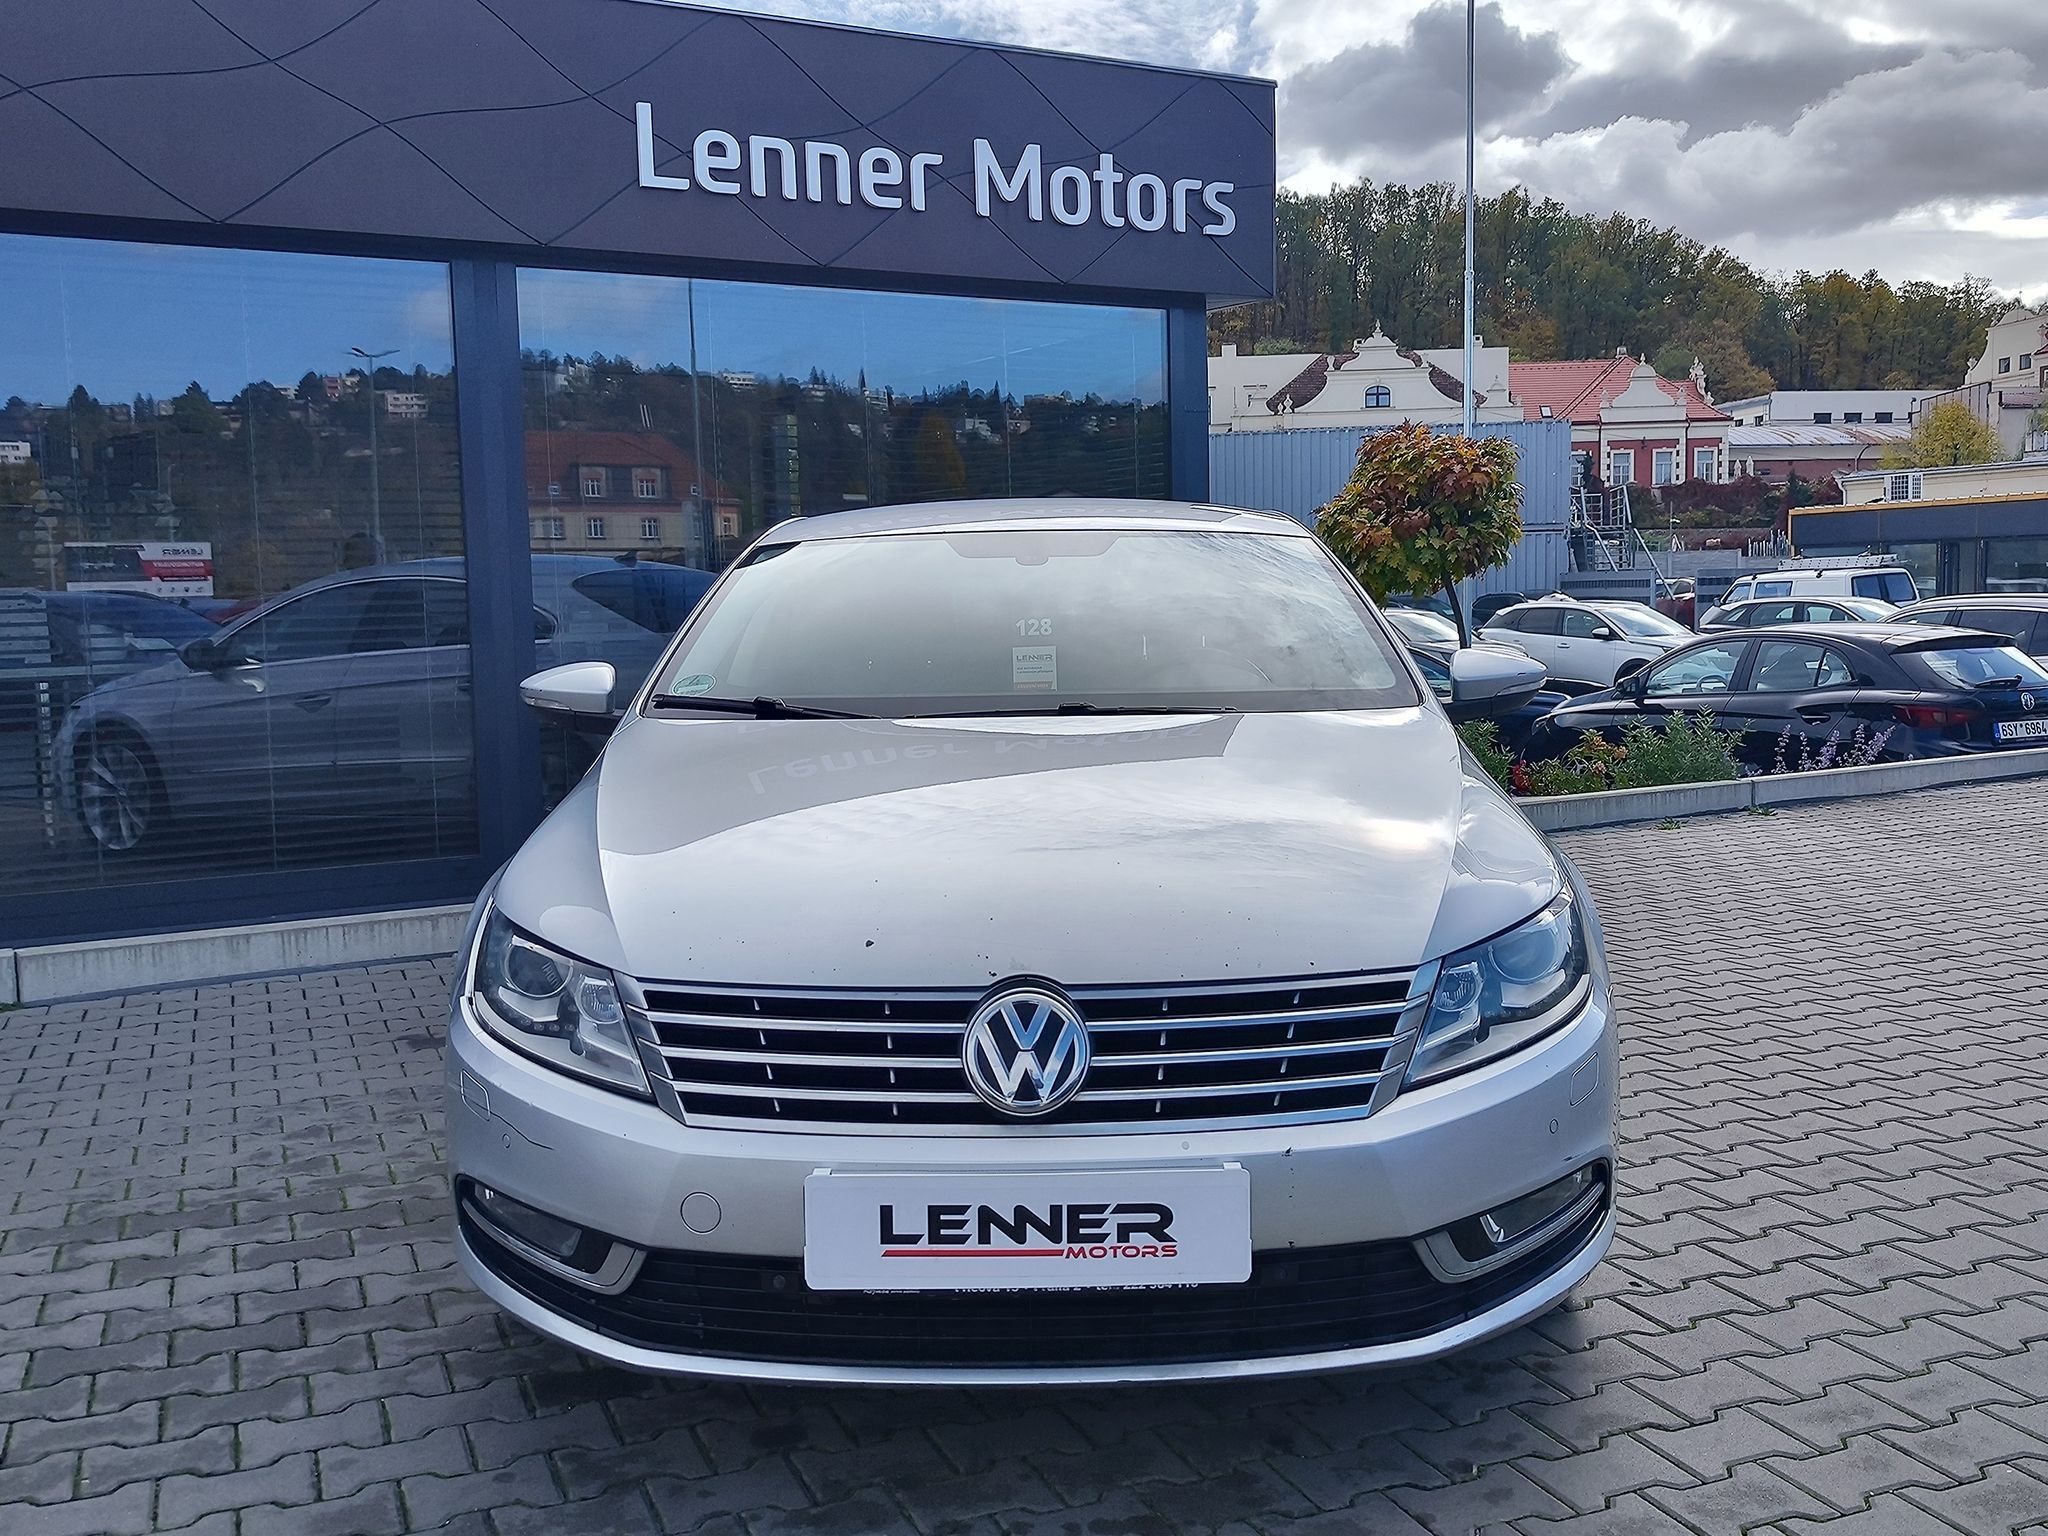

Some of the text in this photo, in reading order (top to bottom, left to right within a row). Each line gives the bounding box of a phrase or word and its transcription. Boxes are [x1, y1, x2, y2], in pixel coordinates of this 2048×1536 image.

[635, 101, 1237, 237] Lenner Motors
[1015, 618, 1053, 637] 128
[2001, 720, 2047, 737] 6SY 6964
[878, 1202, 1179, 1246] LENNER
[1064, 1244, 1179, 1259] MOTORS
